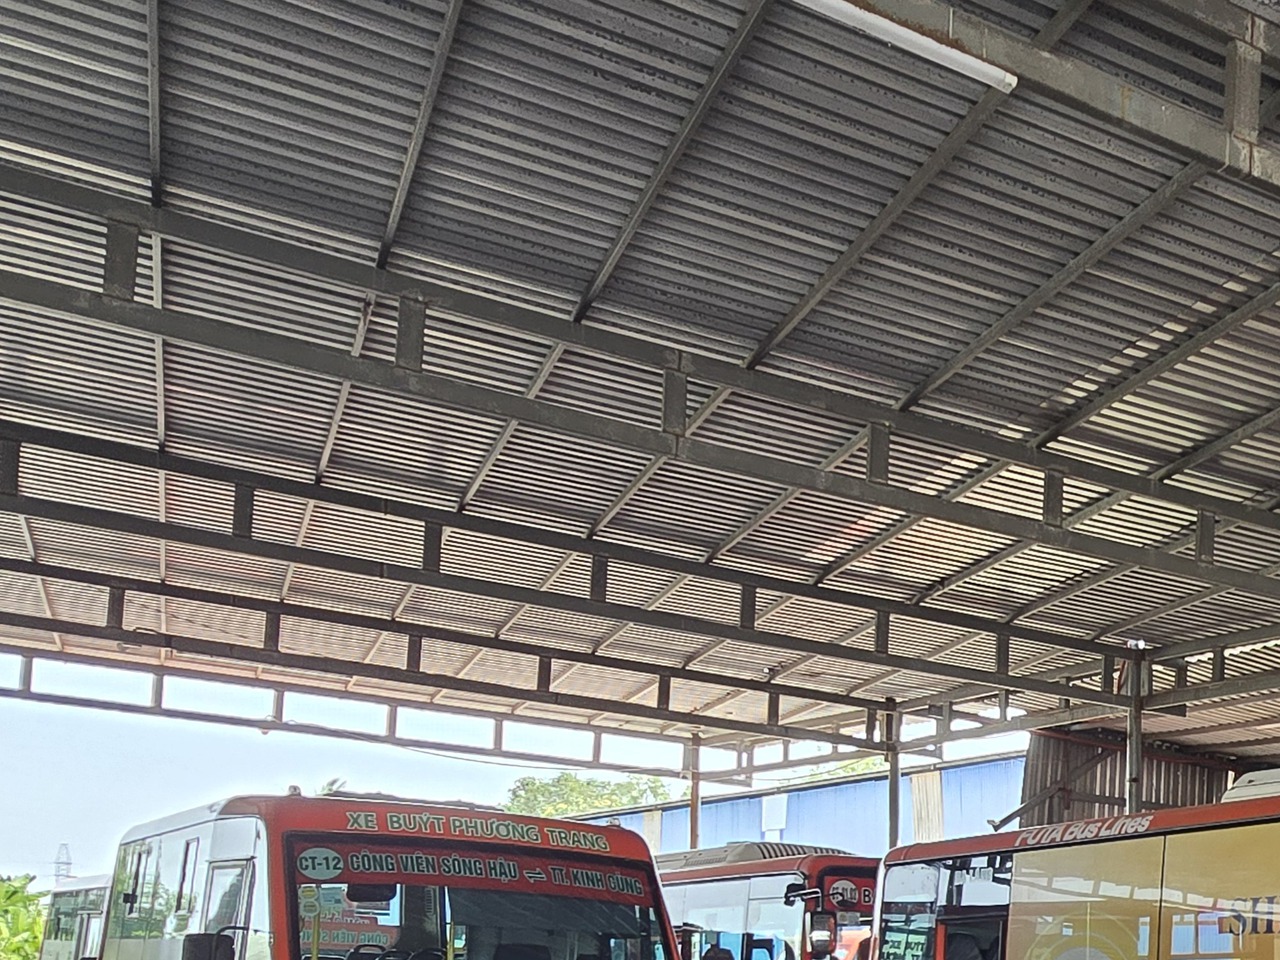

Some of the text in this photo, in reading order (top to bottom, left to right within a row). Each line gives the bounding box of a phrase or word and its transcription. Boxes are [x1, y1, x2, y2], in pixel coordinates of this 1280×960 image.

[346, 811, 611, 852] XE BUÝT PHƯƠNG TRANG
[1014, 815, 1154, 846] FUTA Bus Lines
[299, 856, 343, 871] CT-12
[349, 850, 397, 874] CÔNG
[398, 851, 438, 876] VIÊN
[440, 854, 484, 877] SÔNG
[487, 856, 519, 882] HẬU
[571, 869, 606, 891] KINH
